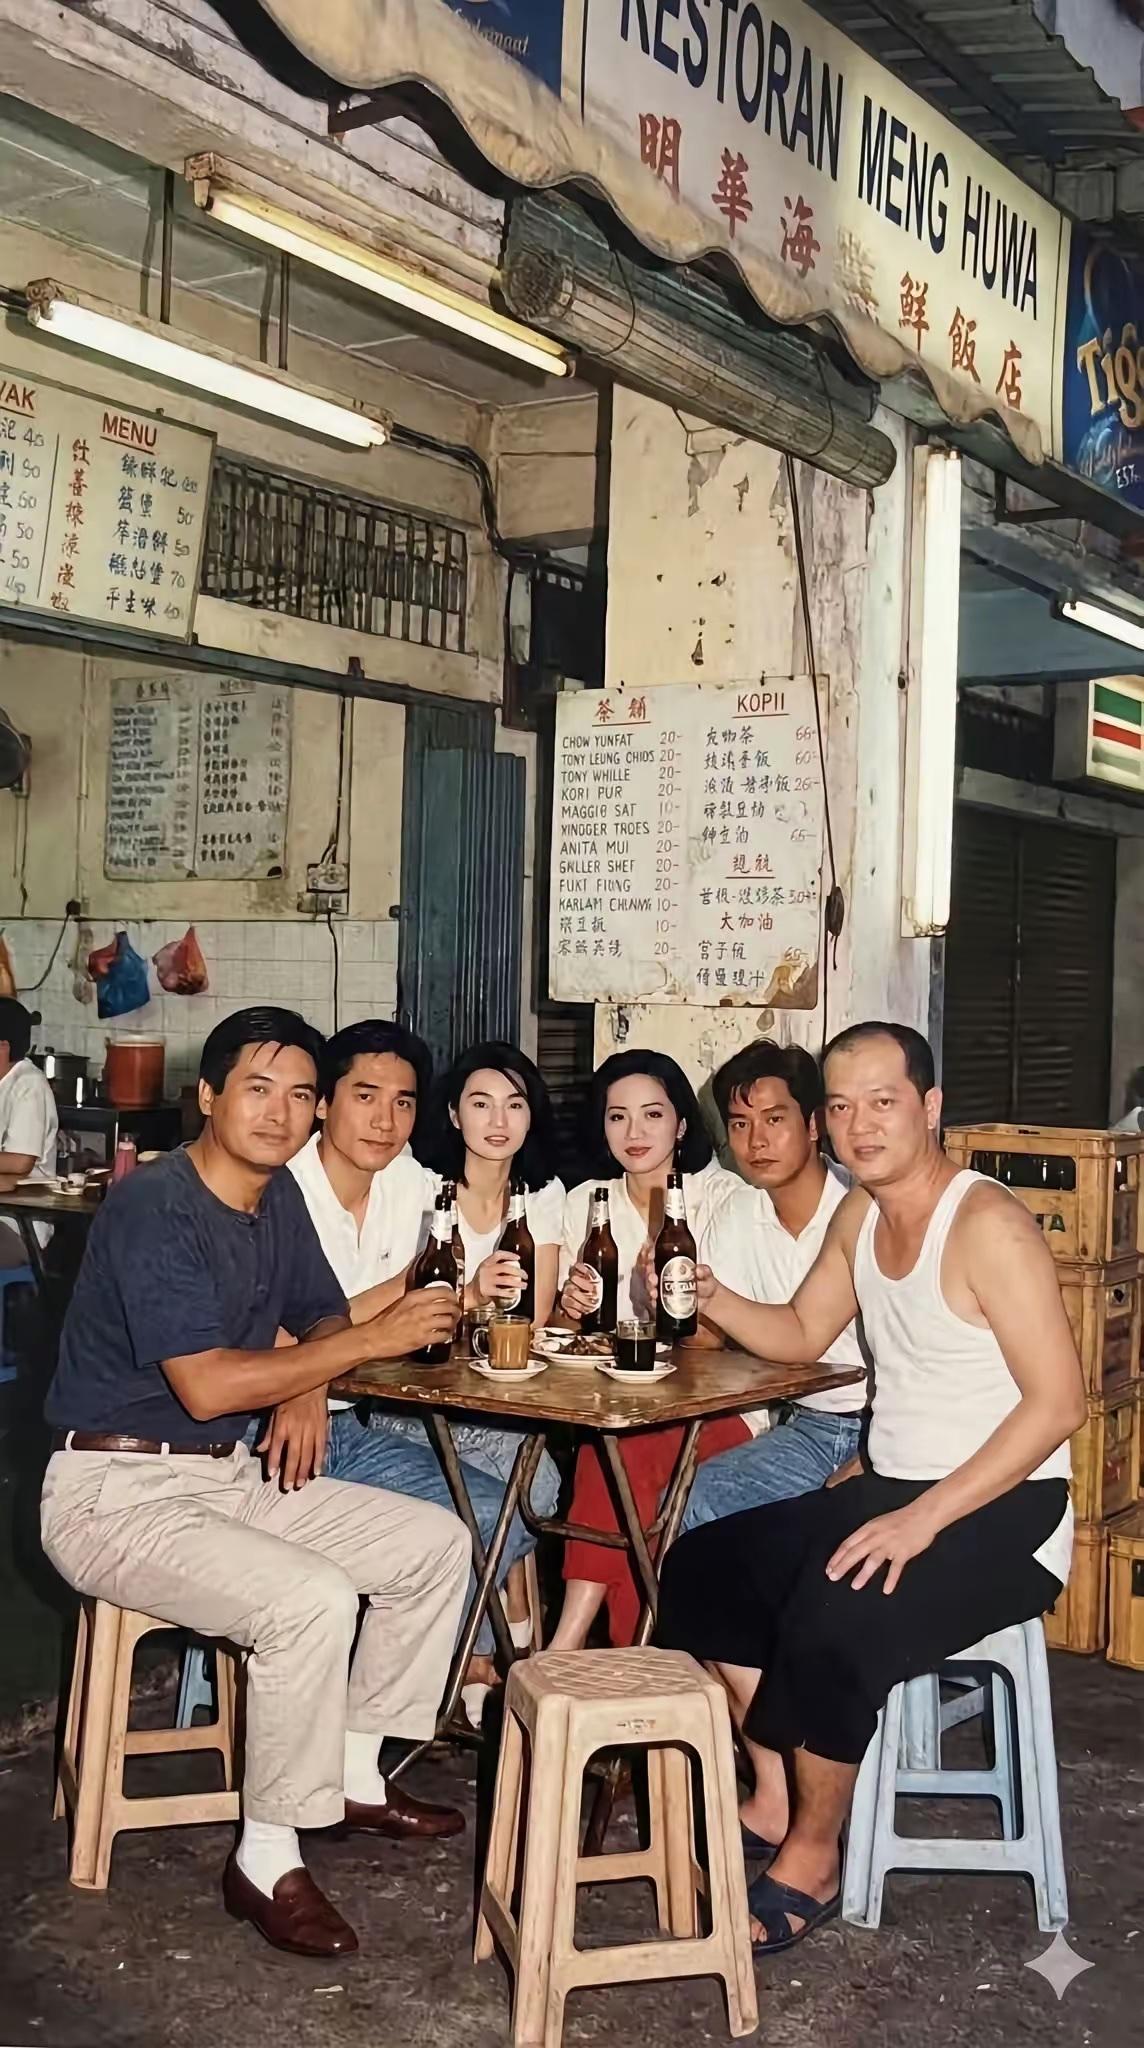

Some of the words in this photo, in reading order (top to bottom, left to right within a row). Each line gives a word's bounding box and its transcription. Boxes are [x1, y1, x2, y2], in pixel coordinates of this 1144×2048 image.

[858, 95, 949, 254] MENG
[961, 176, 1037, 321] HUWA
[102, 412, 157, 447] MENU
[737, 692, 785, 713] KOPII
[562, 736, 590, 749] CHOW
[595, 733, 635, 748] YUNFAT
[561, 754, 586, 766] TONY
[589, 752, 620, 766] LEUNG
[560, 771, 588, 784] TONY
[561, 787, 589, 801] KORI
[598, 785, 622, 800] PUR
[560, 841, 598, 855] ANITA
[606, 841, 629, 855] MUI
